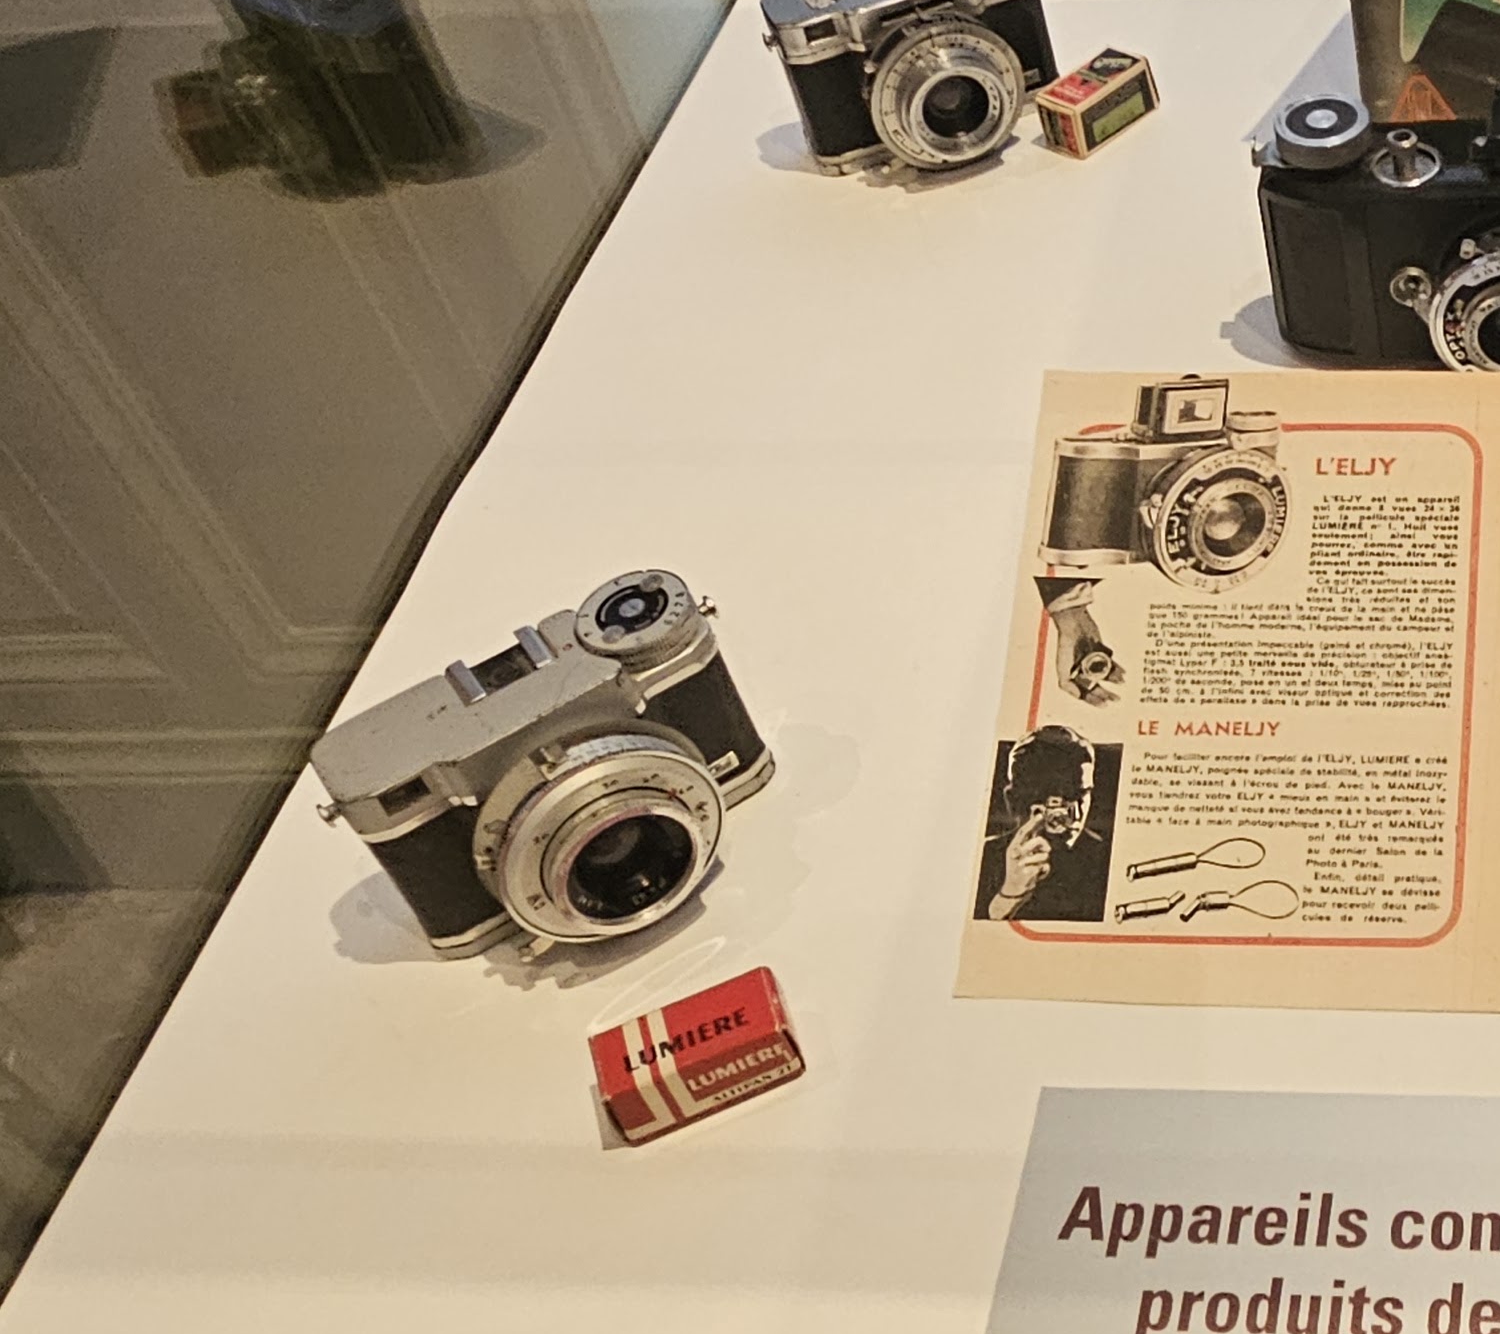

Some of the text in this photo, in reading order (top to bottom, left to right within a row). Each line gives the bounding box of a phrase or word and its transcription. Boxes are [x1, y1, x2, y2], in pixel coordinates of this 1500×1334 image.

[1314, 455, 1396, 476] L'ELJY
[1137, 719, 1278, 737] LE MANELJY
[622, 1006, 749, 1073] LUMIERE
[686, 1043, 787, 1092] LUMIERE
[1056, 1185, 1369, 1260] Appareils
